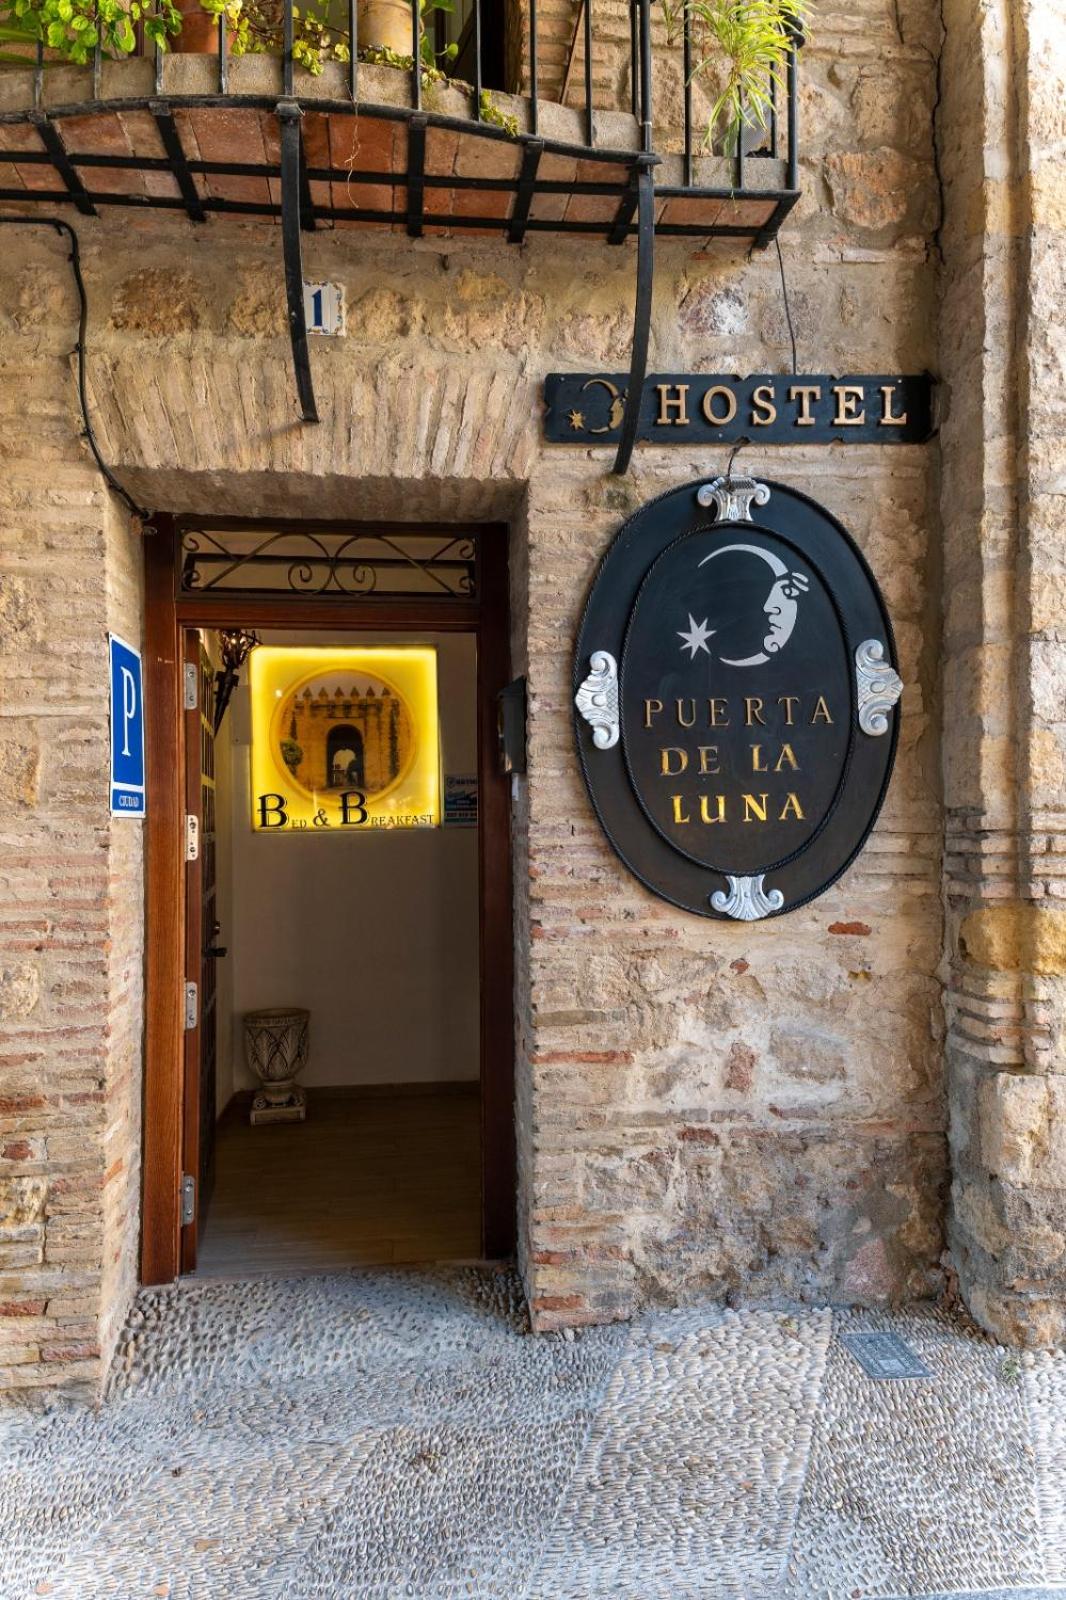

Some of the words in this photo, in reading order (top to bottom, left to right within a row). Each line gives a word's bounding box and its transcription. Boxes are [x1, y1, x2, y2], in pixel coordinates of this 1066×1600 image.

[312, 289, 323, 327] 1
[656, 384, 907, 426] HOSTEL
[120, 666, 137, 757] P
[644, 696, 834, 728] PUERTA
[660, 745, 720, 776] DE
[749, 743, 801, 772] LA
[313, 808, 331, 827] &
[670, 792, 806, 824] LUNA
